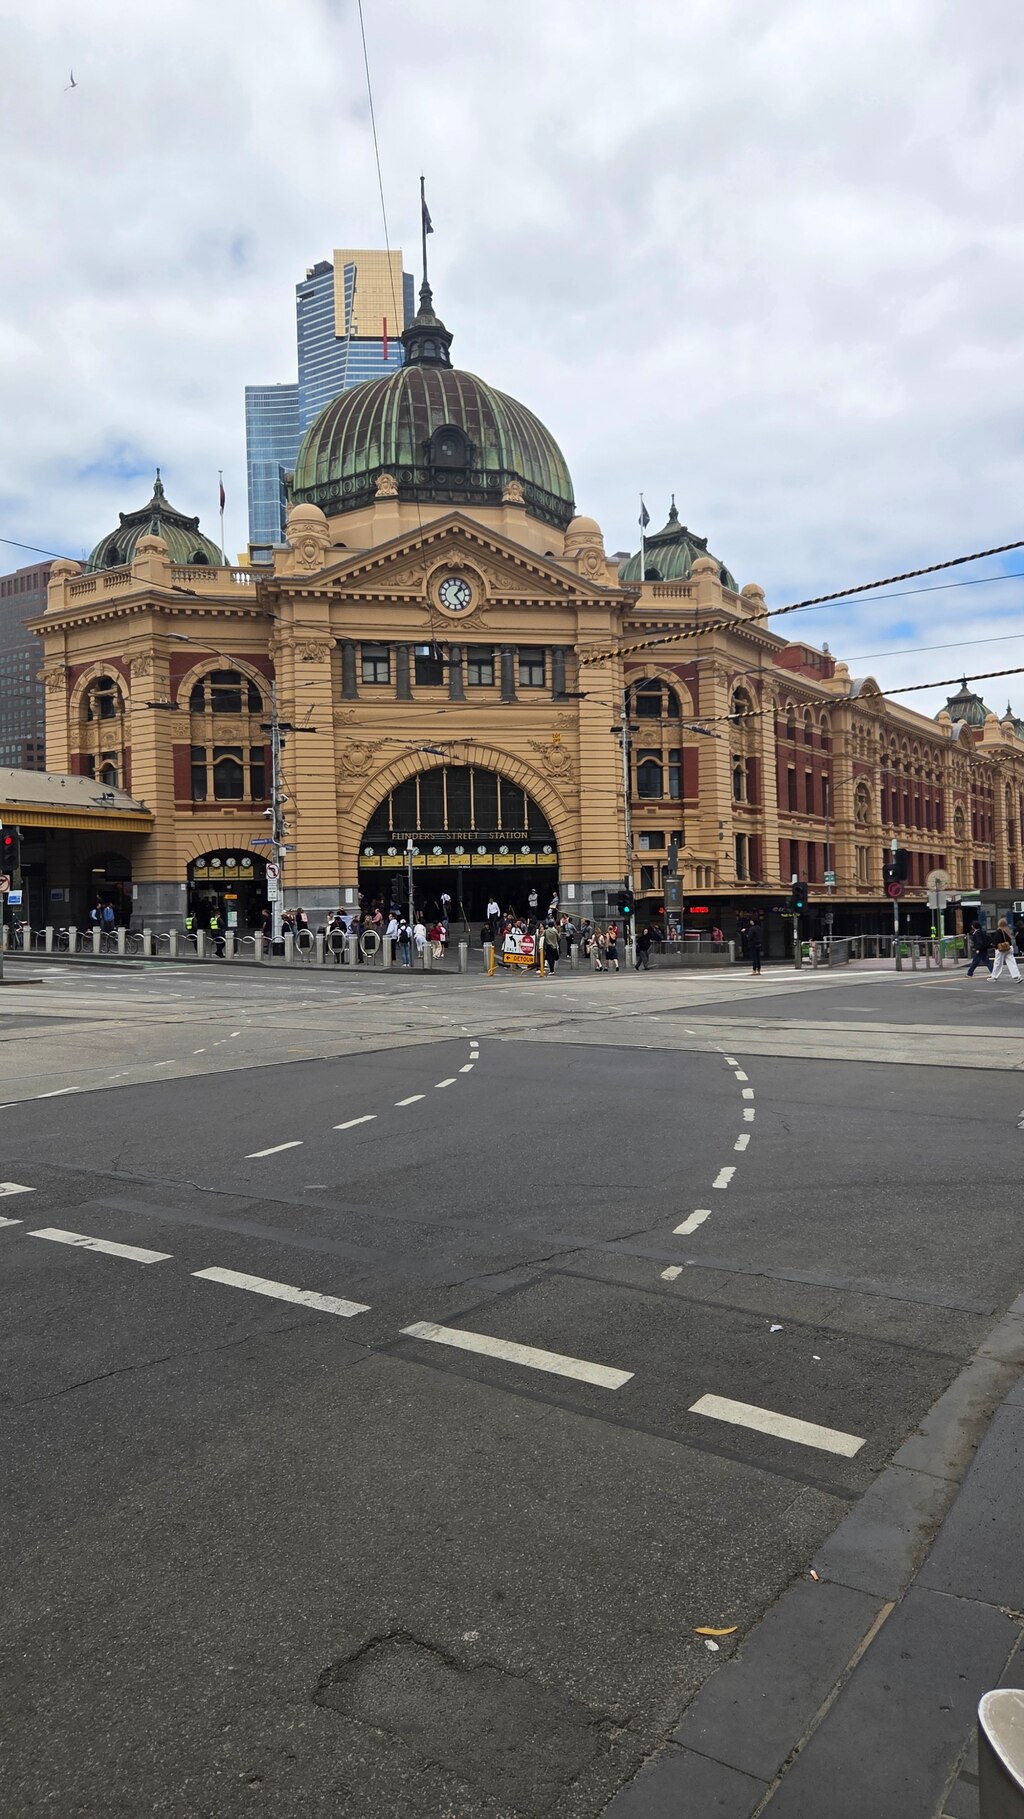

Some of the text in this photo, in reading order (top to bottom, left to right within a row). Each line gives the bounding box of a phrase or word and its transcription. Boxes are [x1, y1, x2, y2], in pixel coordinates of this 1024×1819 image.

[391, 831, 528, 840] FLINDERS STREET STATION
